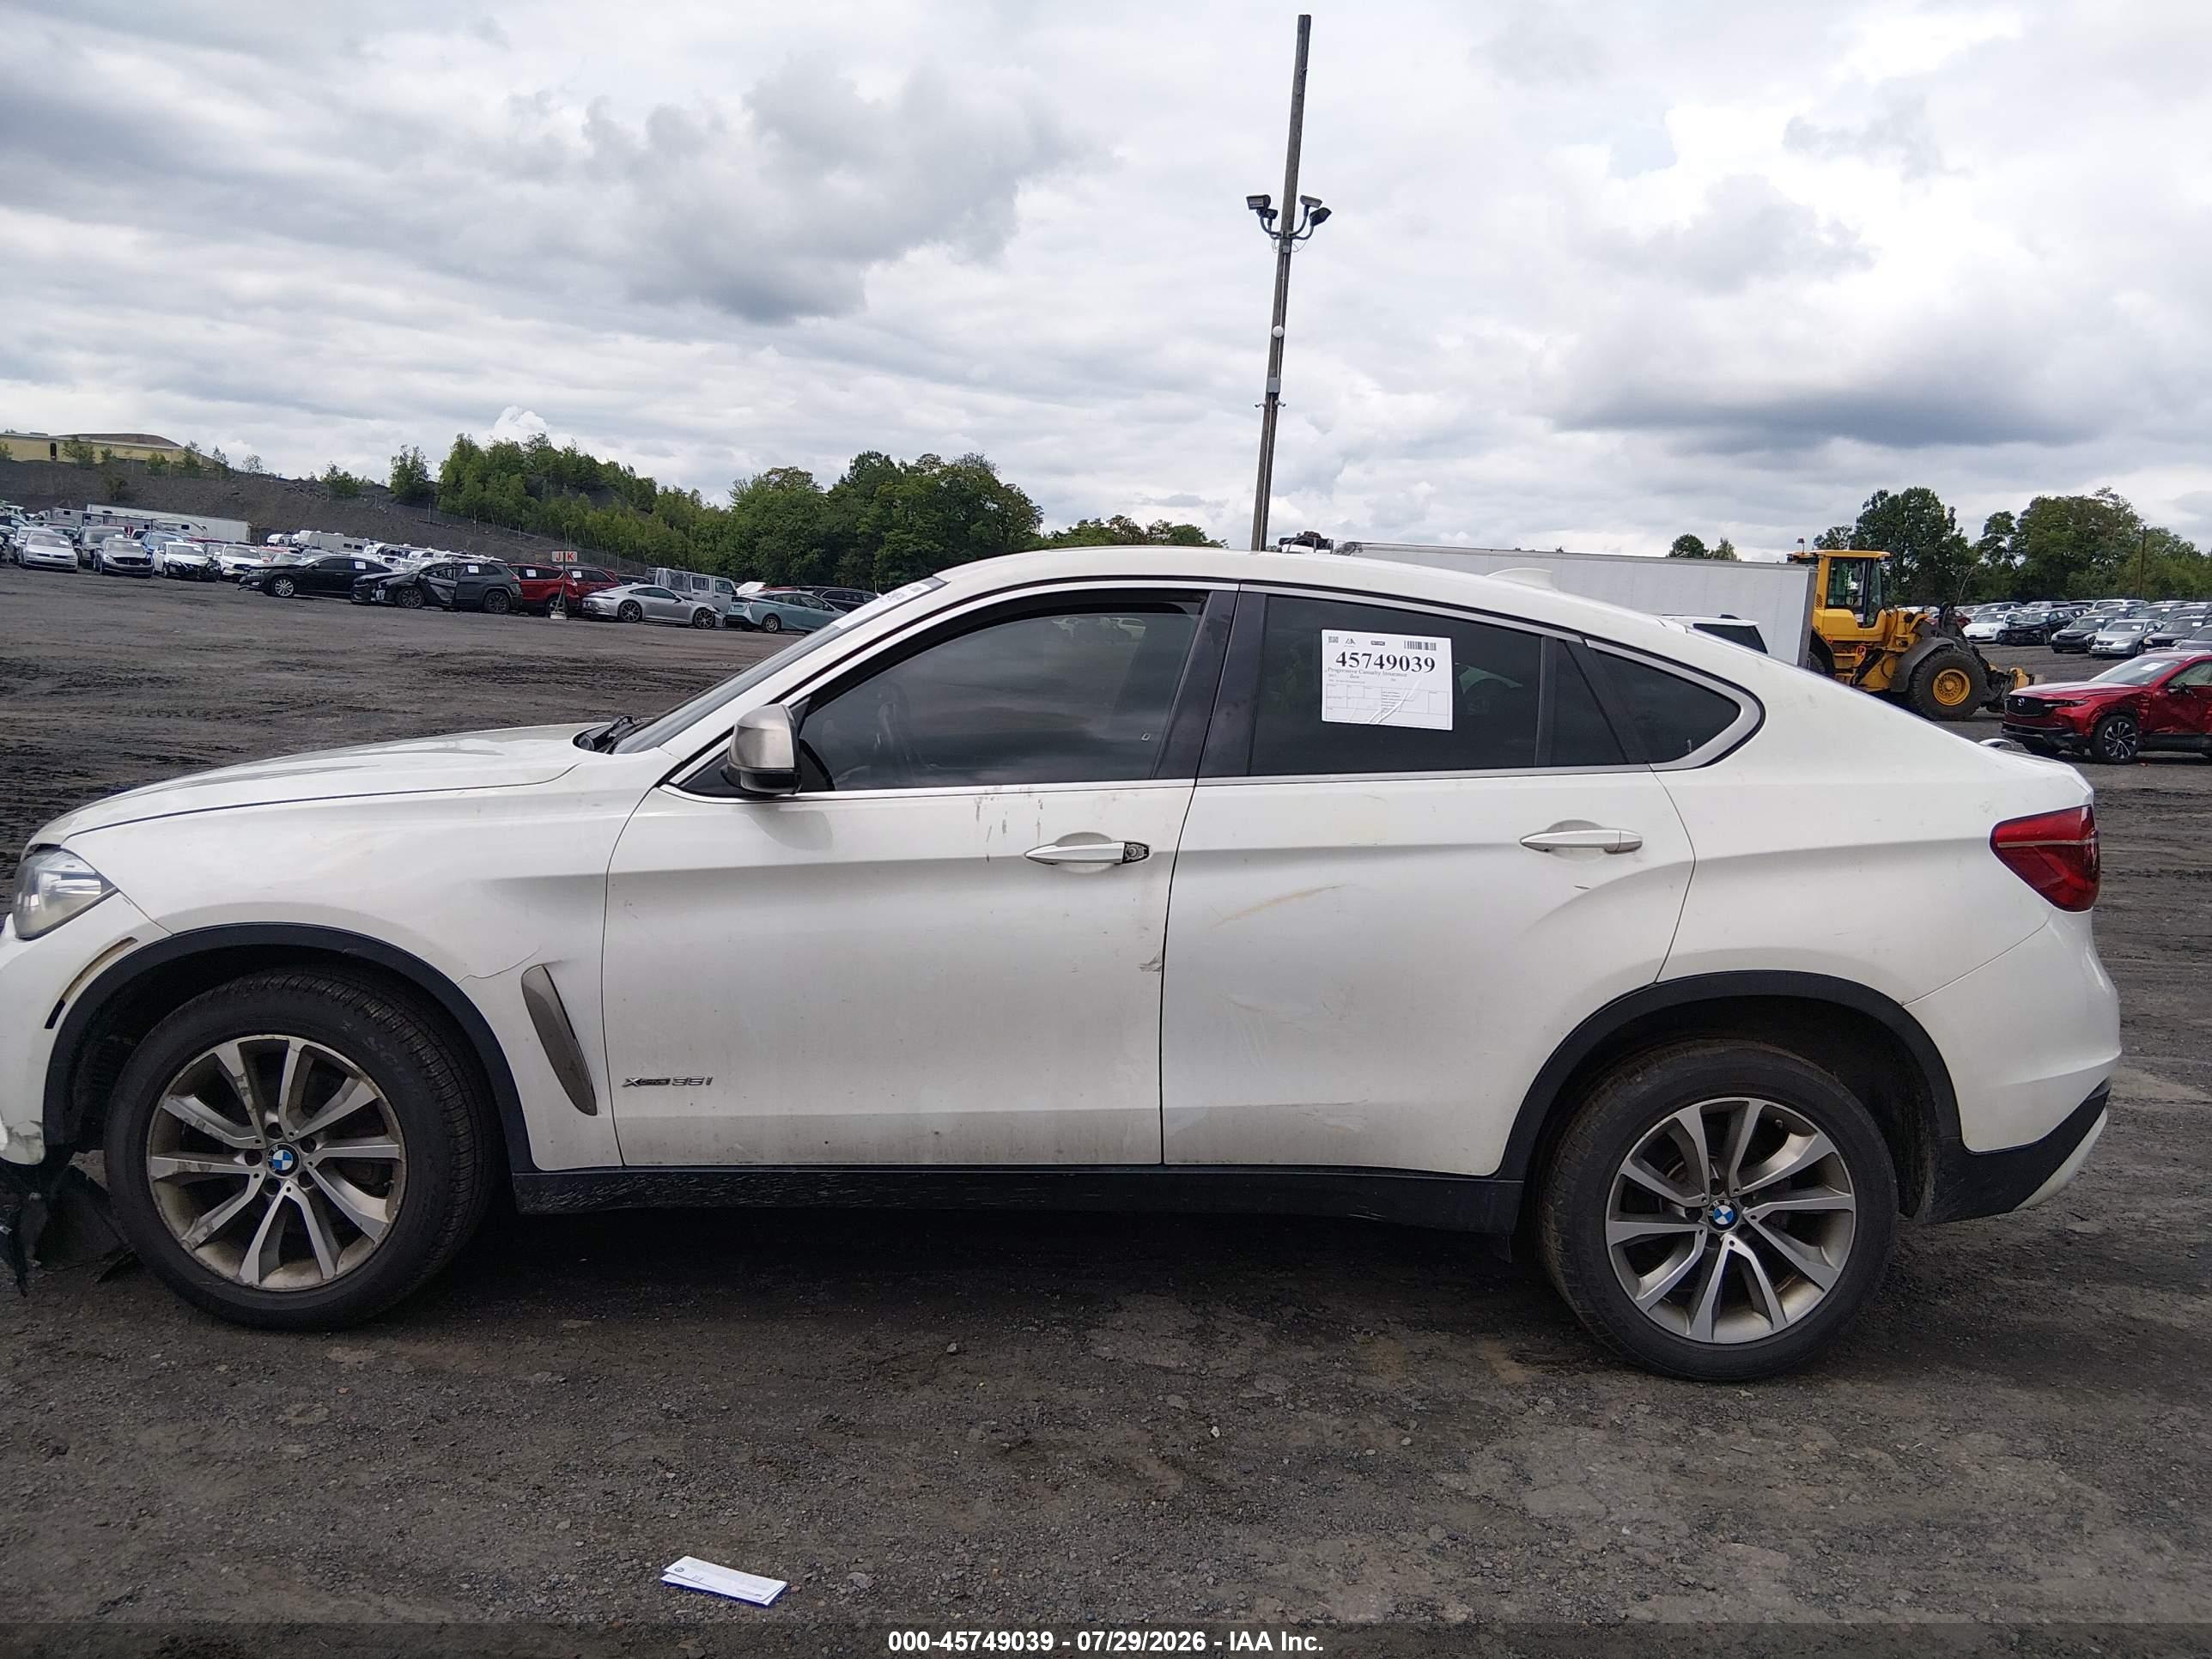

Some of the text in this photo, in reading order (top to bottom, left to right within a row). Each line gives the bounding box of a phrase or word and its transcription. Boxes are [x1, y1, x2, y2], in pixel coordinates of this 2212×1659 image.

[556, 552, 574, 561] J K
[1335, 651, 1436, 673] 45749039
